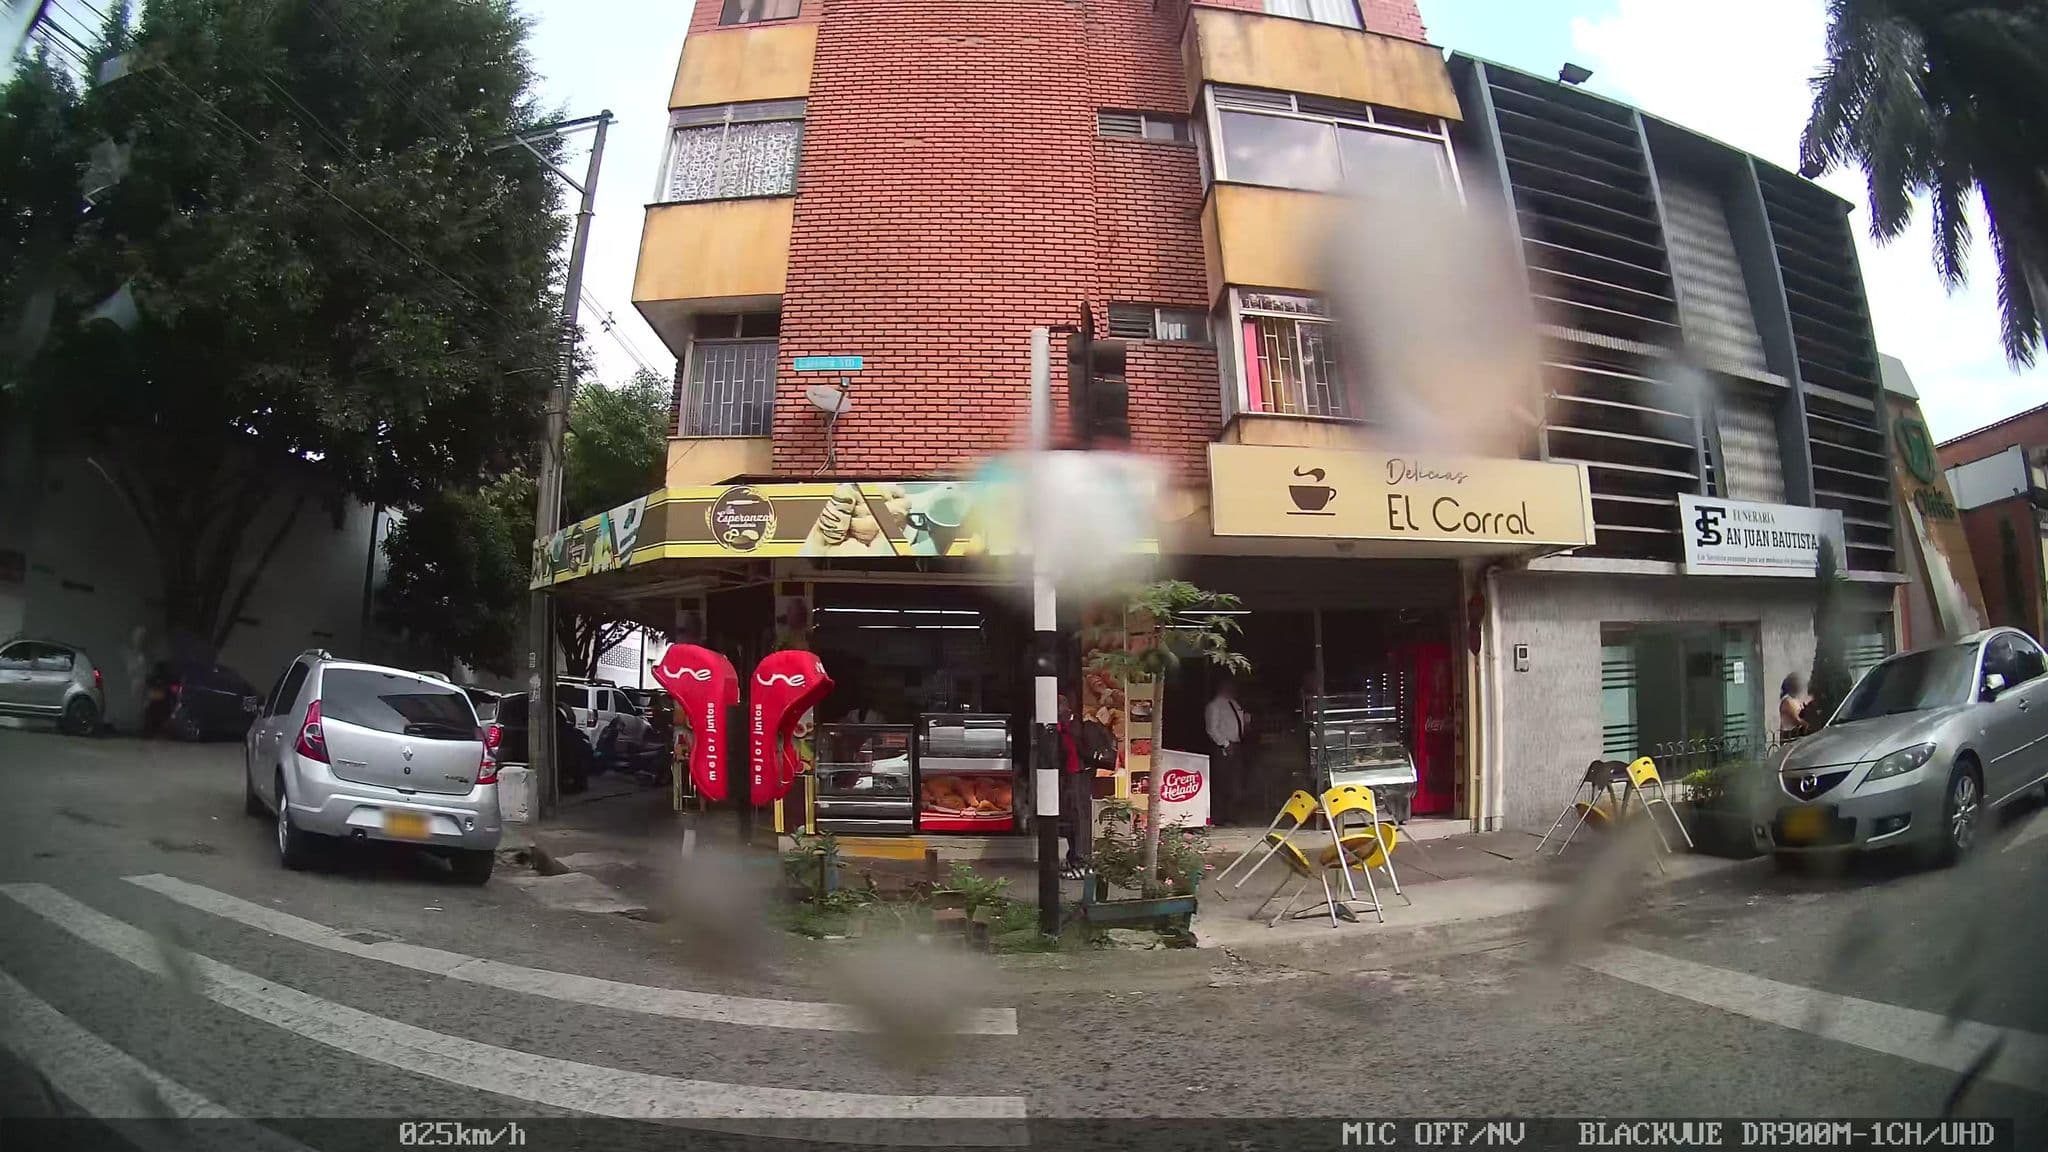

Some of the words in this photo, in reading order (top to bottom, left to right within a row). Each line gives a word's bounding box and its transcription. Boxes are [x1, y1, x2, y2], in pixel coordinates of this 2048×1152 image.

[1386, 458, 1469, 485] Delicias
[716, 510, 770, 526] Esperanza
[1432, 497, 1535, 535] Corral
[1744, 529, 1770, 548] JUAN
[1772, 530, 1819, 550] BAUTISTA
[663, 665, 712, 682] une
[756, 673, 806, 687] une
[705, 702, 717, 733] juntos
[752, 703, 764, 735] juntos
[706, 738, 718, 781] mejor
[753, 741, 764, 785] mejor
[1161, 782, 1199, 800] Helado
[1166, 773, 1196, 787] Crem
